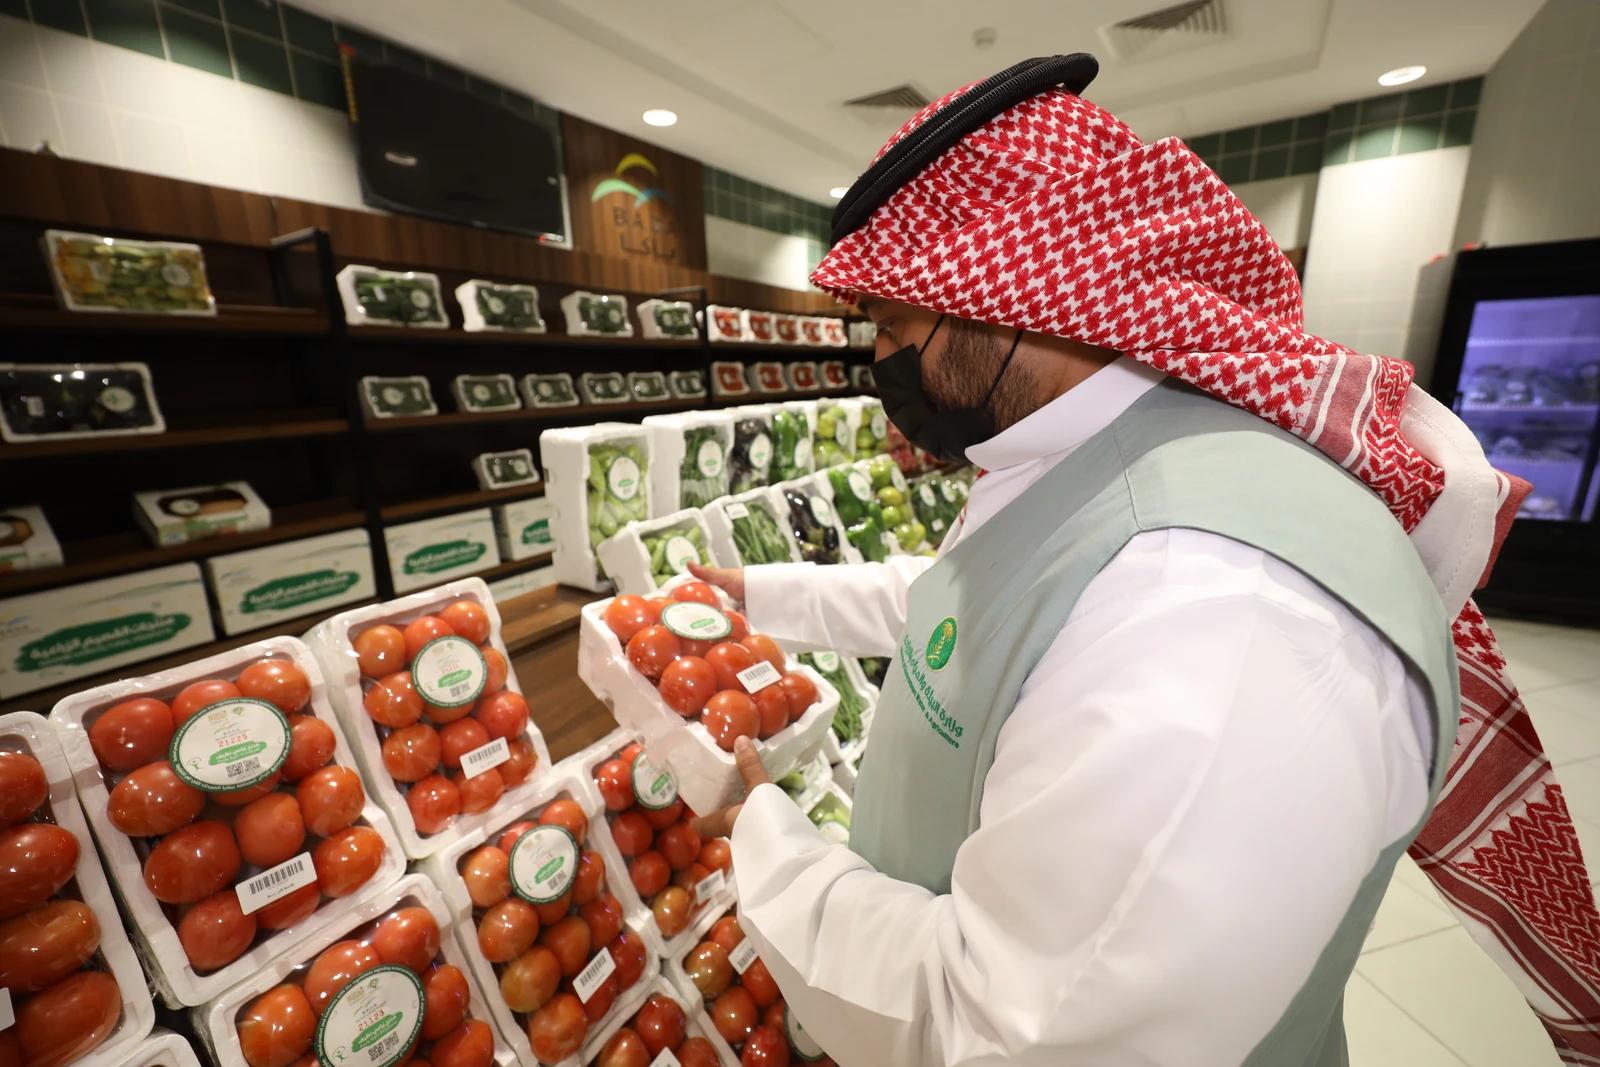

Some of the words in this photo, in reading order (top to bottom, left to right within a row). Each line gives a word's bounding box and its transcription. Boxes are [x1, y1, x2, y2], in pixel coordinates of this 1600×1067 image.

[924, 685, 940, 714] البيئة
[938, 708, 964, 737] وزارة
[218, 733, 248, 748] 21225
[357, 1009, 386, 1031] 21123
